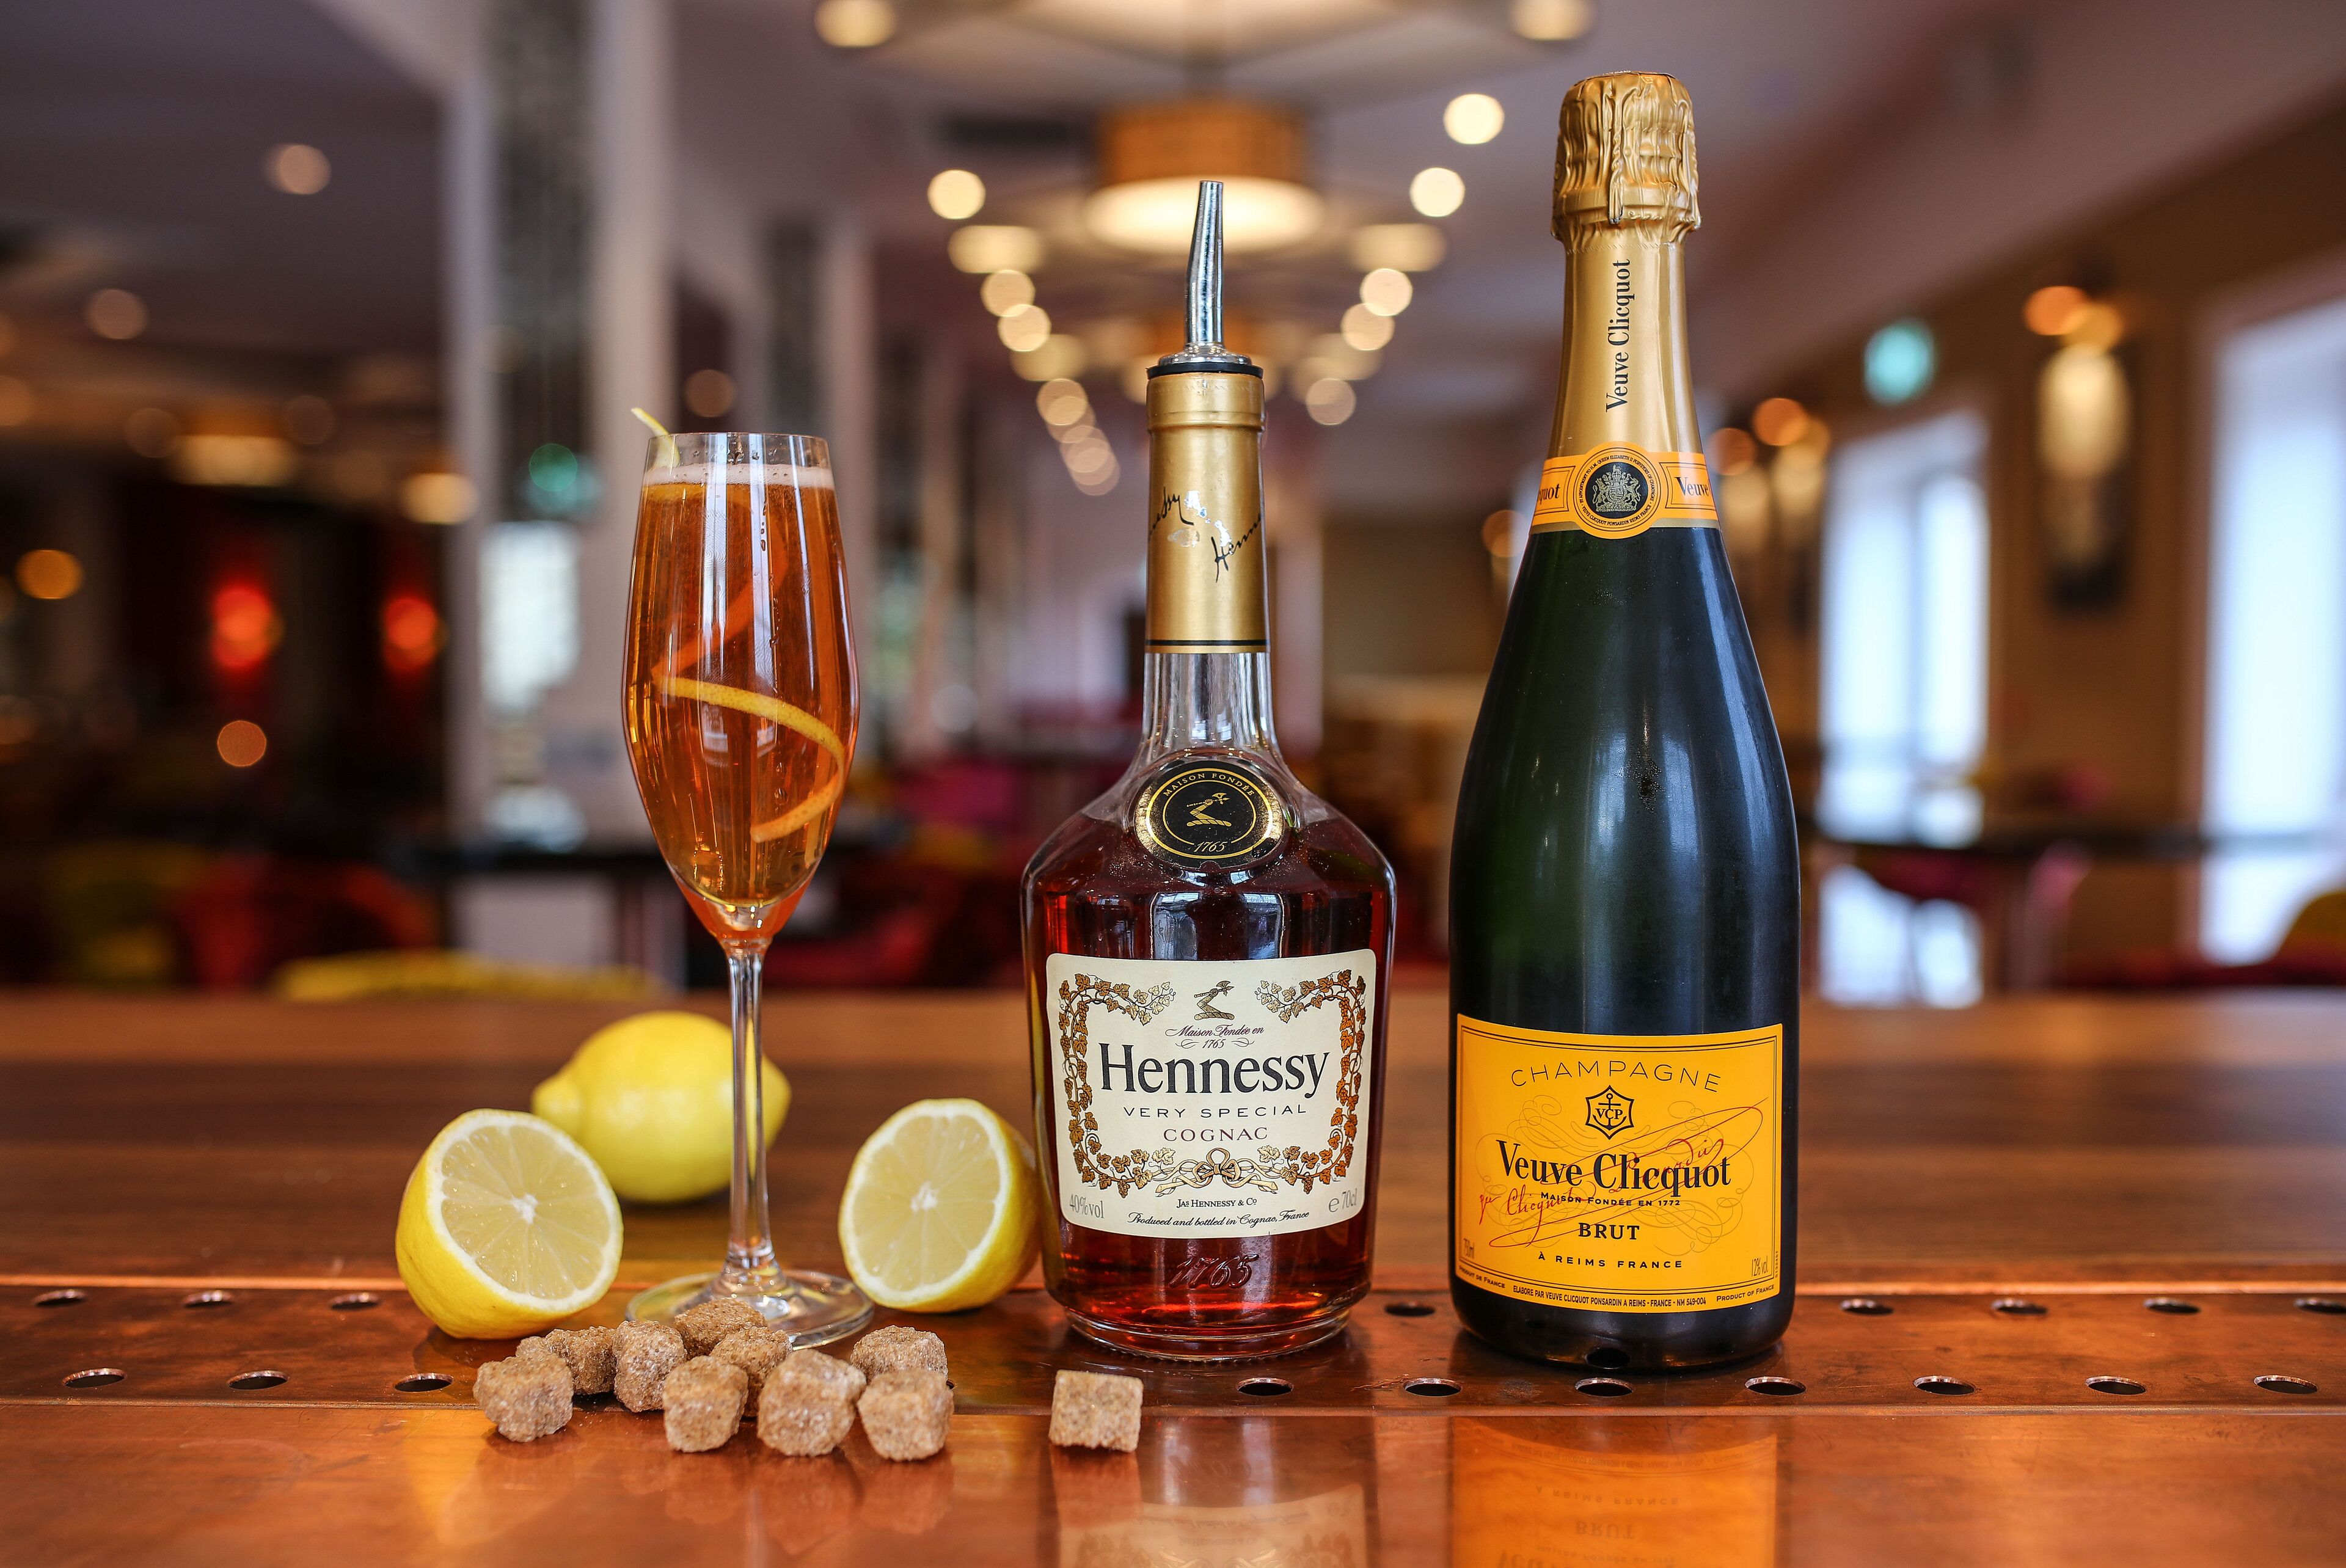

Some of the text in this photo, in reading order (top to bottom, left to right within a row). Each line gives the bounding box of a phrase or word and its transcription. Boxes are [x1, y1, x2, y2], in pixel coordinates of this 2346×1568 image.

[1606, 258, 1635, 412] Veuve Clicquot
[1597, 456, 1609, 464] QUEEN
[1674, 476, 1709, 496] Veuve
[1163, 773, 1255, 797] MAISON FONDÉE
[1193, 841, 1228, 853] 1765
[1164, 1025, 1213, 1037] Maison
[1213, 1023, 1251, 1038] Fondée
[1202, 1038, 1227, 1049] 1765
[1098, 1042, 1331, 1099] Hennessy
[1511, 1060, 1721, 1093] CHAMPAGNE
[1123, 1104, 1307, 1118] VERY SPECIAL
[1595, 1107, 1624, 1120] VCP
[1163, 1127, 1268, 1142] COGNAC
[1496, 1139, 1731, 1198] Veuve Clicquot
[1191, 1199, 1237, 1208] HENNESSY
[1541, 1191, 1582, 1203] MAISON
[1588, 1197, 1632, 1206] FONDÉE
[1128, 1212, 1172, 1225] Produced
[1172, 1217, 1192, 1226] and
[1194, 1216, 1223, 1226] bottled
[1277, 1209, 1310, 1222] France
[1578, 1222, 1640, 1240] BRUT
[1538, 1251, 1683, 1269] À REIMS FRANCE
[1168, 1253, 1260, 1289] 1765
[1483, 1276, 1505, 1289] FRANCE
[1535, 1289, 1544, 1299] PAR
[1546, 1291, 1563, 1301] VEUVE
[1563, 1294, 1590, 1304] CLICQUOT
[1590, 1297, 1622, 1307] PONSARDIN
[1629, 1299, 1646, 1307] REIMS
[1686, 1297, 1706, 1306] 549-004
[1716, 1293, 1745, 1302] PRODUCT
[1755, 1283, 1775, 1295] FRANCE
